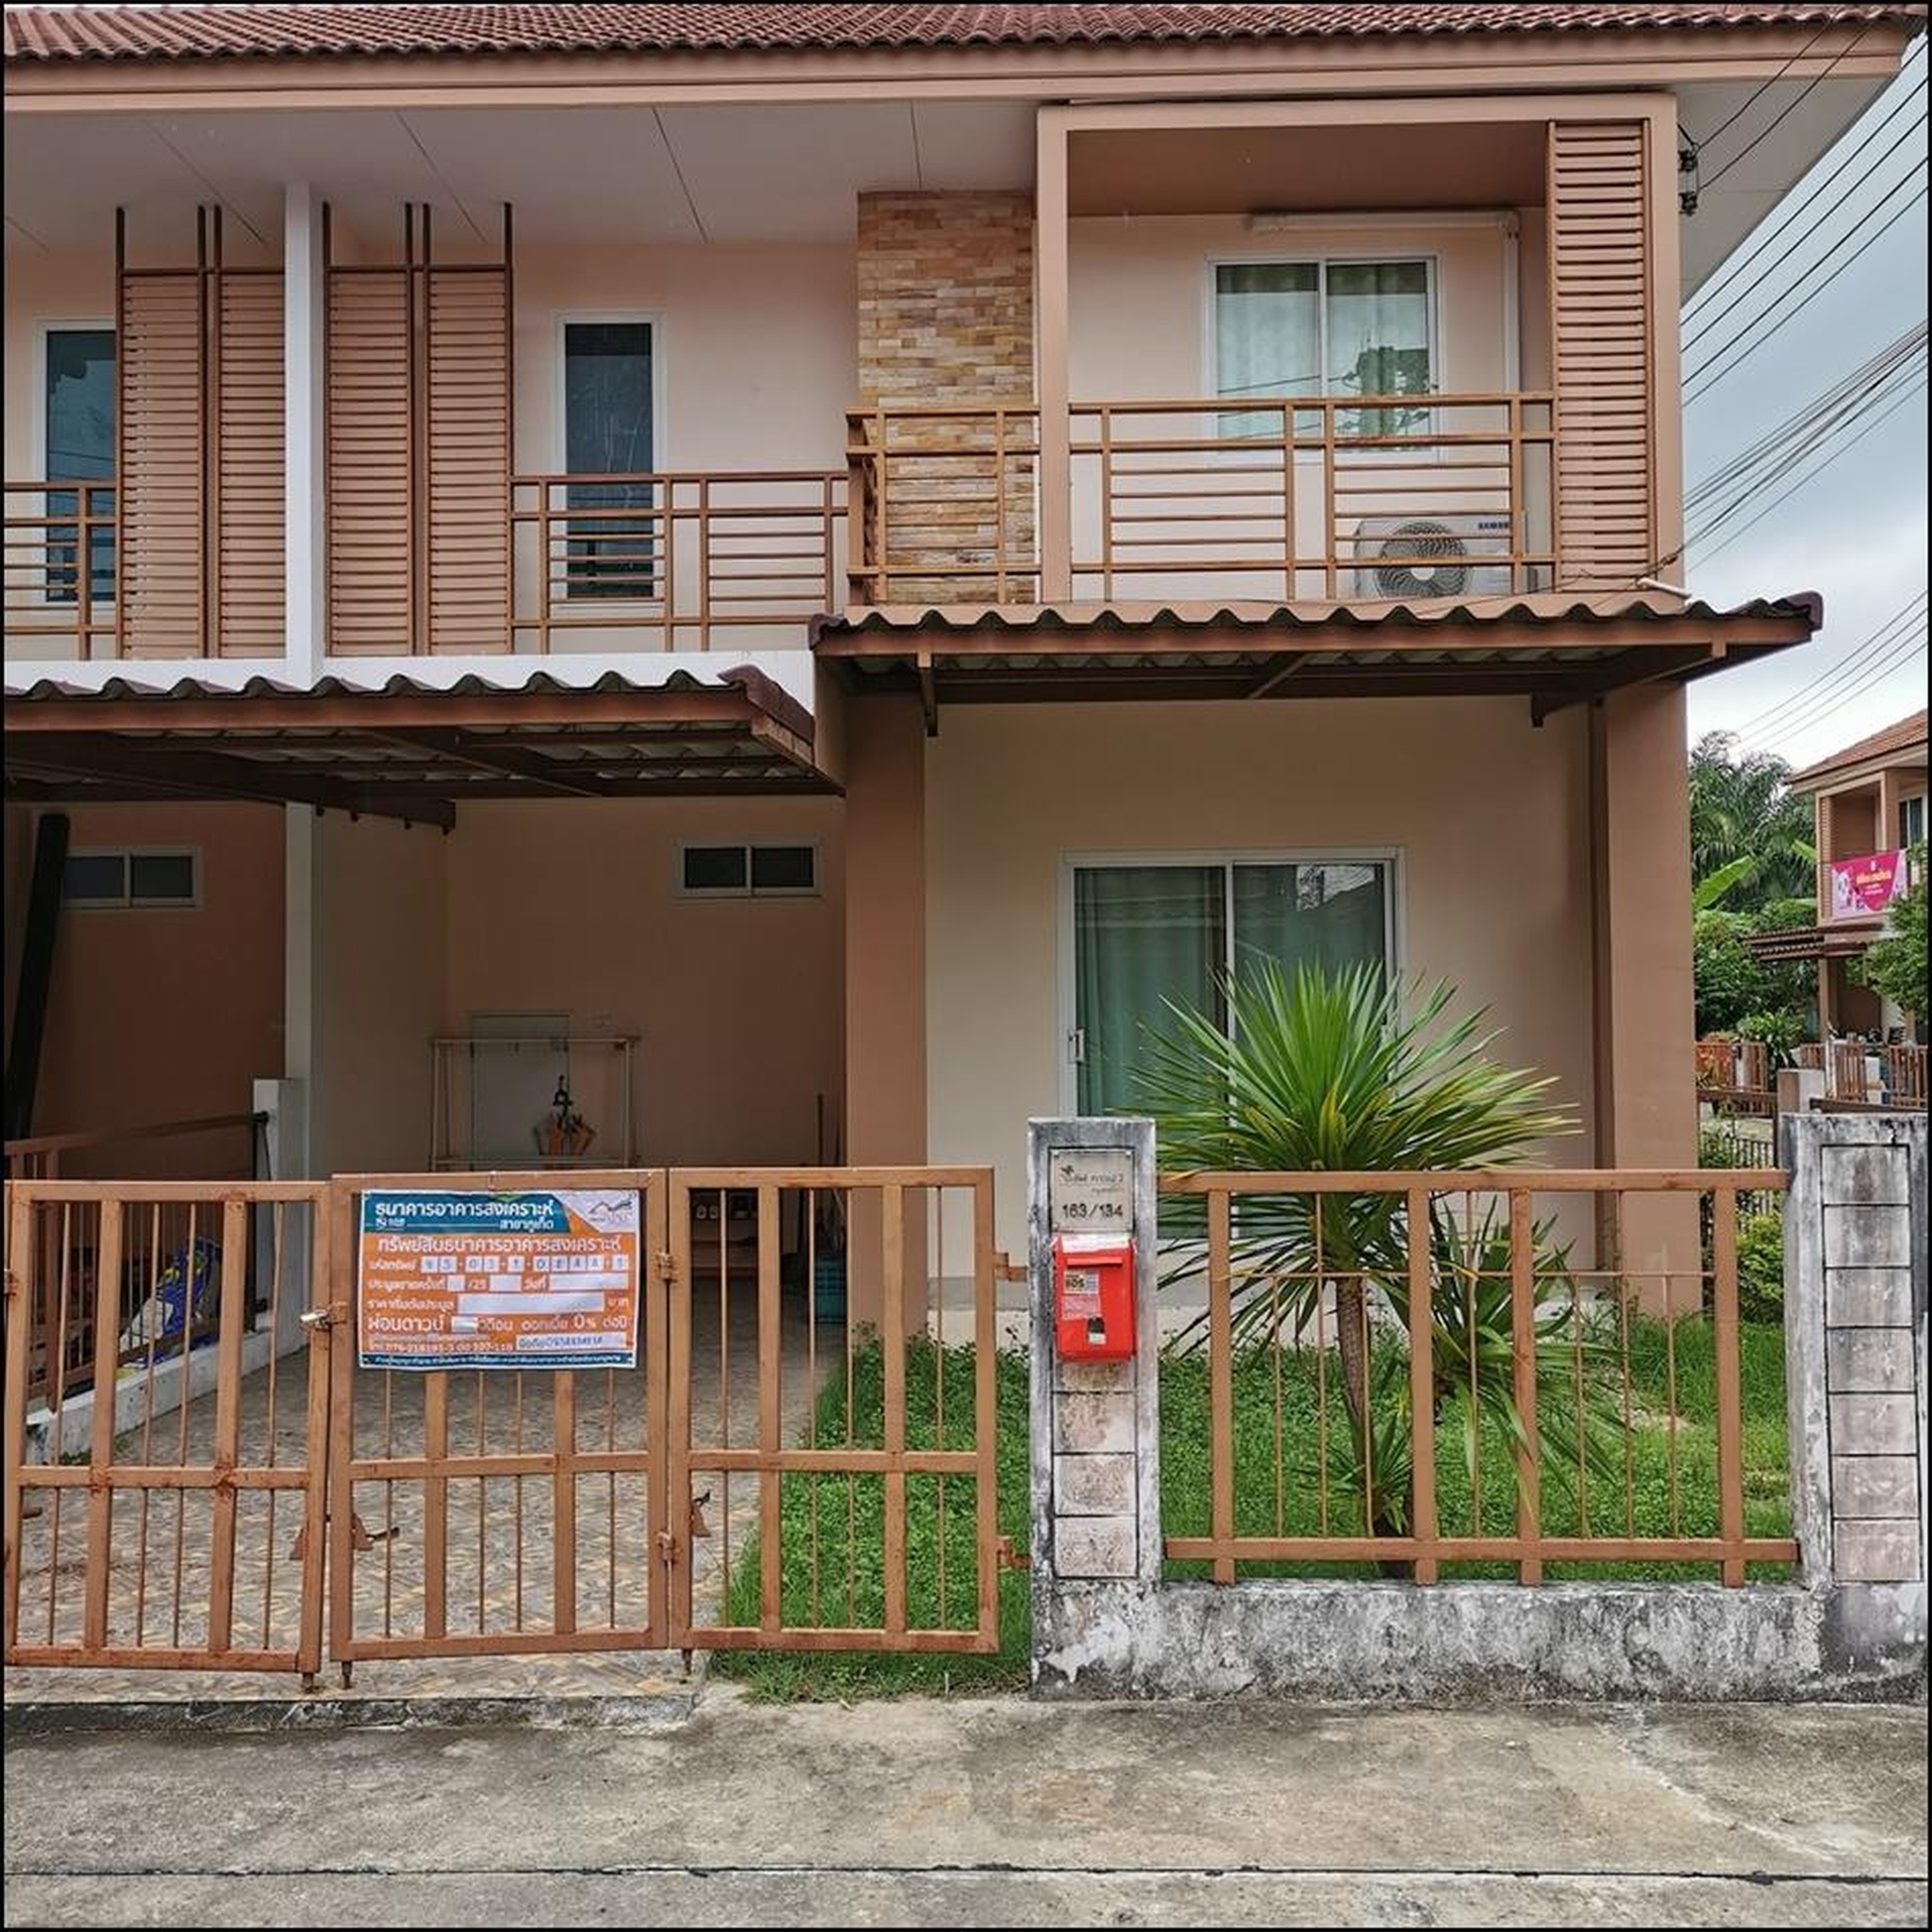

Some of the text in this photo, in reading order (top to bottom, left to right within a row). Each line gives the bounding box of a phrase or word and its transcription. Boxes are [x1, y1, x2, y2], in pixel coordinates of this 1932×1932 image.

[375, 1199, 555, 1217] ธนาคารอาคารสงเคราะห์
[499, 1216, 554, 1233] สาขาภูเก็ต
